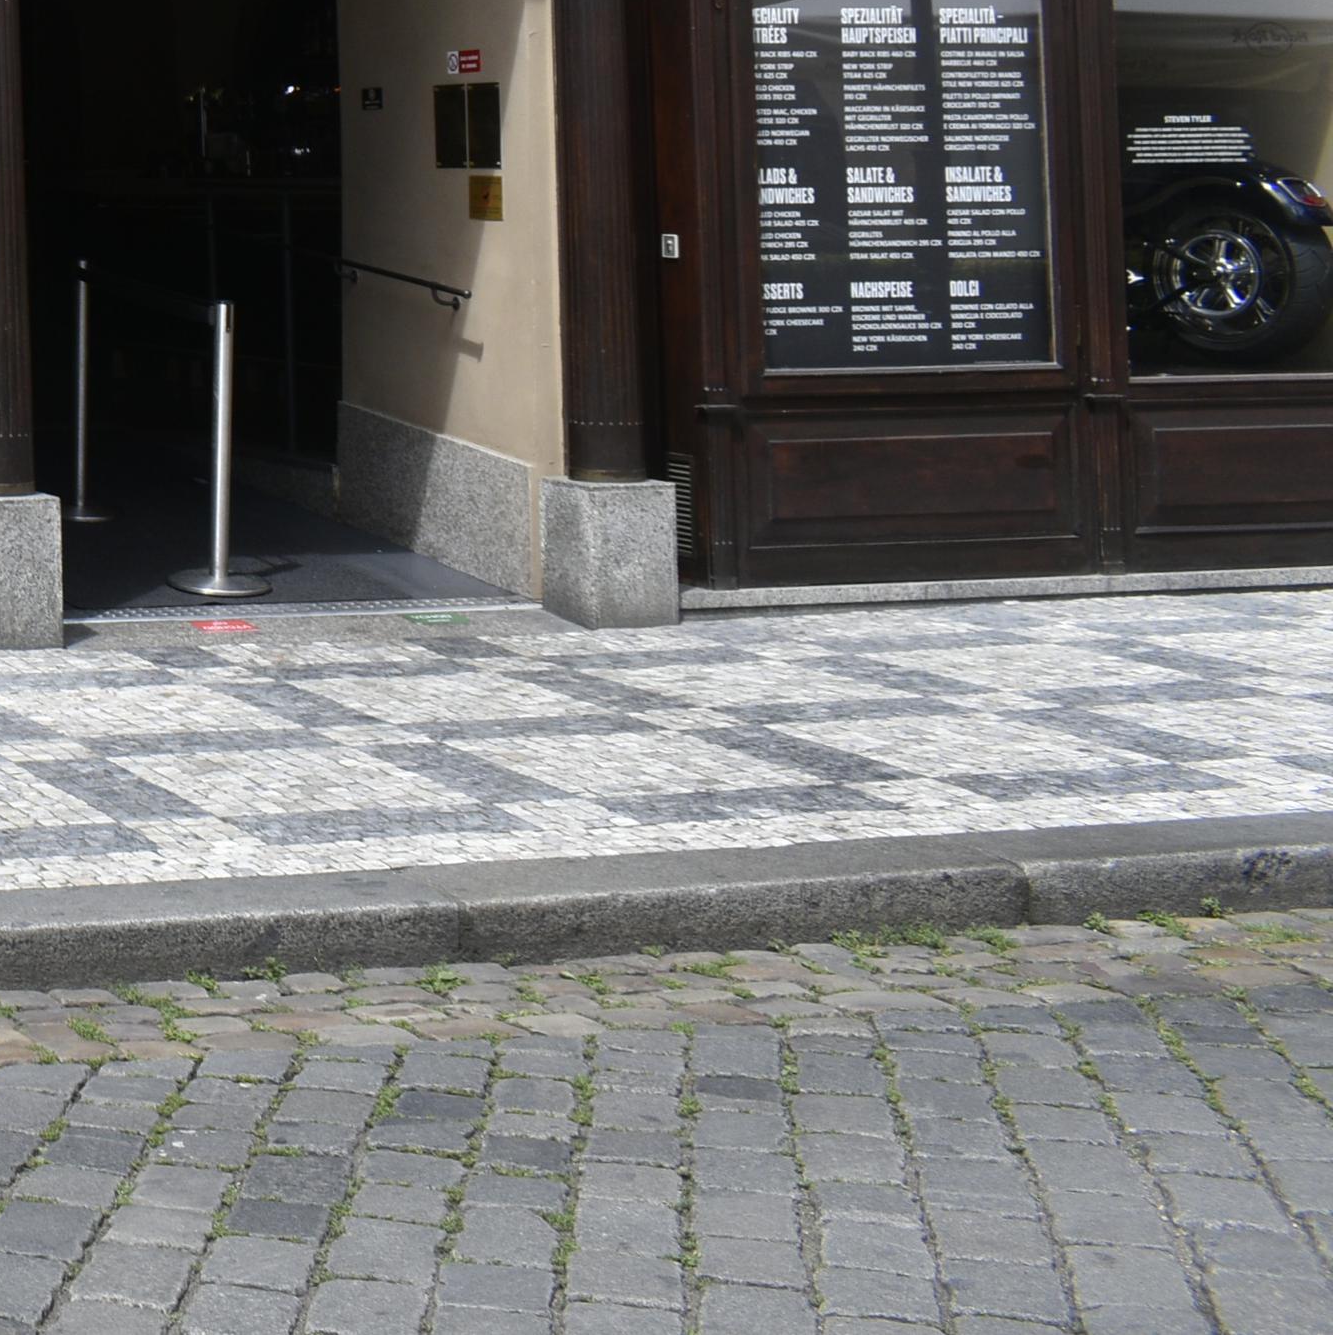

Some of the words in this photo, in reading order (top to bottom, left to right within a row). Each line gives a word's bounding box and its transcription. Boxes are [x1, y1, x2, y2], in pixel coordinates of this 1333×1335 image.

[840, 4, 903, 25] SPEZIALITÄT
[841, 26, 916, 44] HAUPTSPEISEN
[939, 26, 972, 43] PIATTI
[973, 26, 1027, 43] PRINCIPALI
[846, 166, 883, 183] SALATE
[886, 166, 895, 183] &
[945, 166, 991, 183] INSALATE
[993, 166, 1003, 182] &
[847, 186, 914, 203] SANDWICHES
[946, 185, 1012, 202] SANDWICHES
[850, 280, 912, 298] NACHSPEISE
[949, 279, 979, 297] DOLCI
